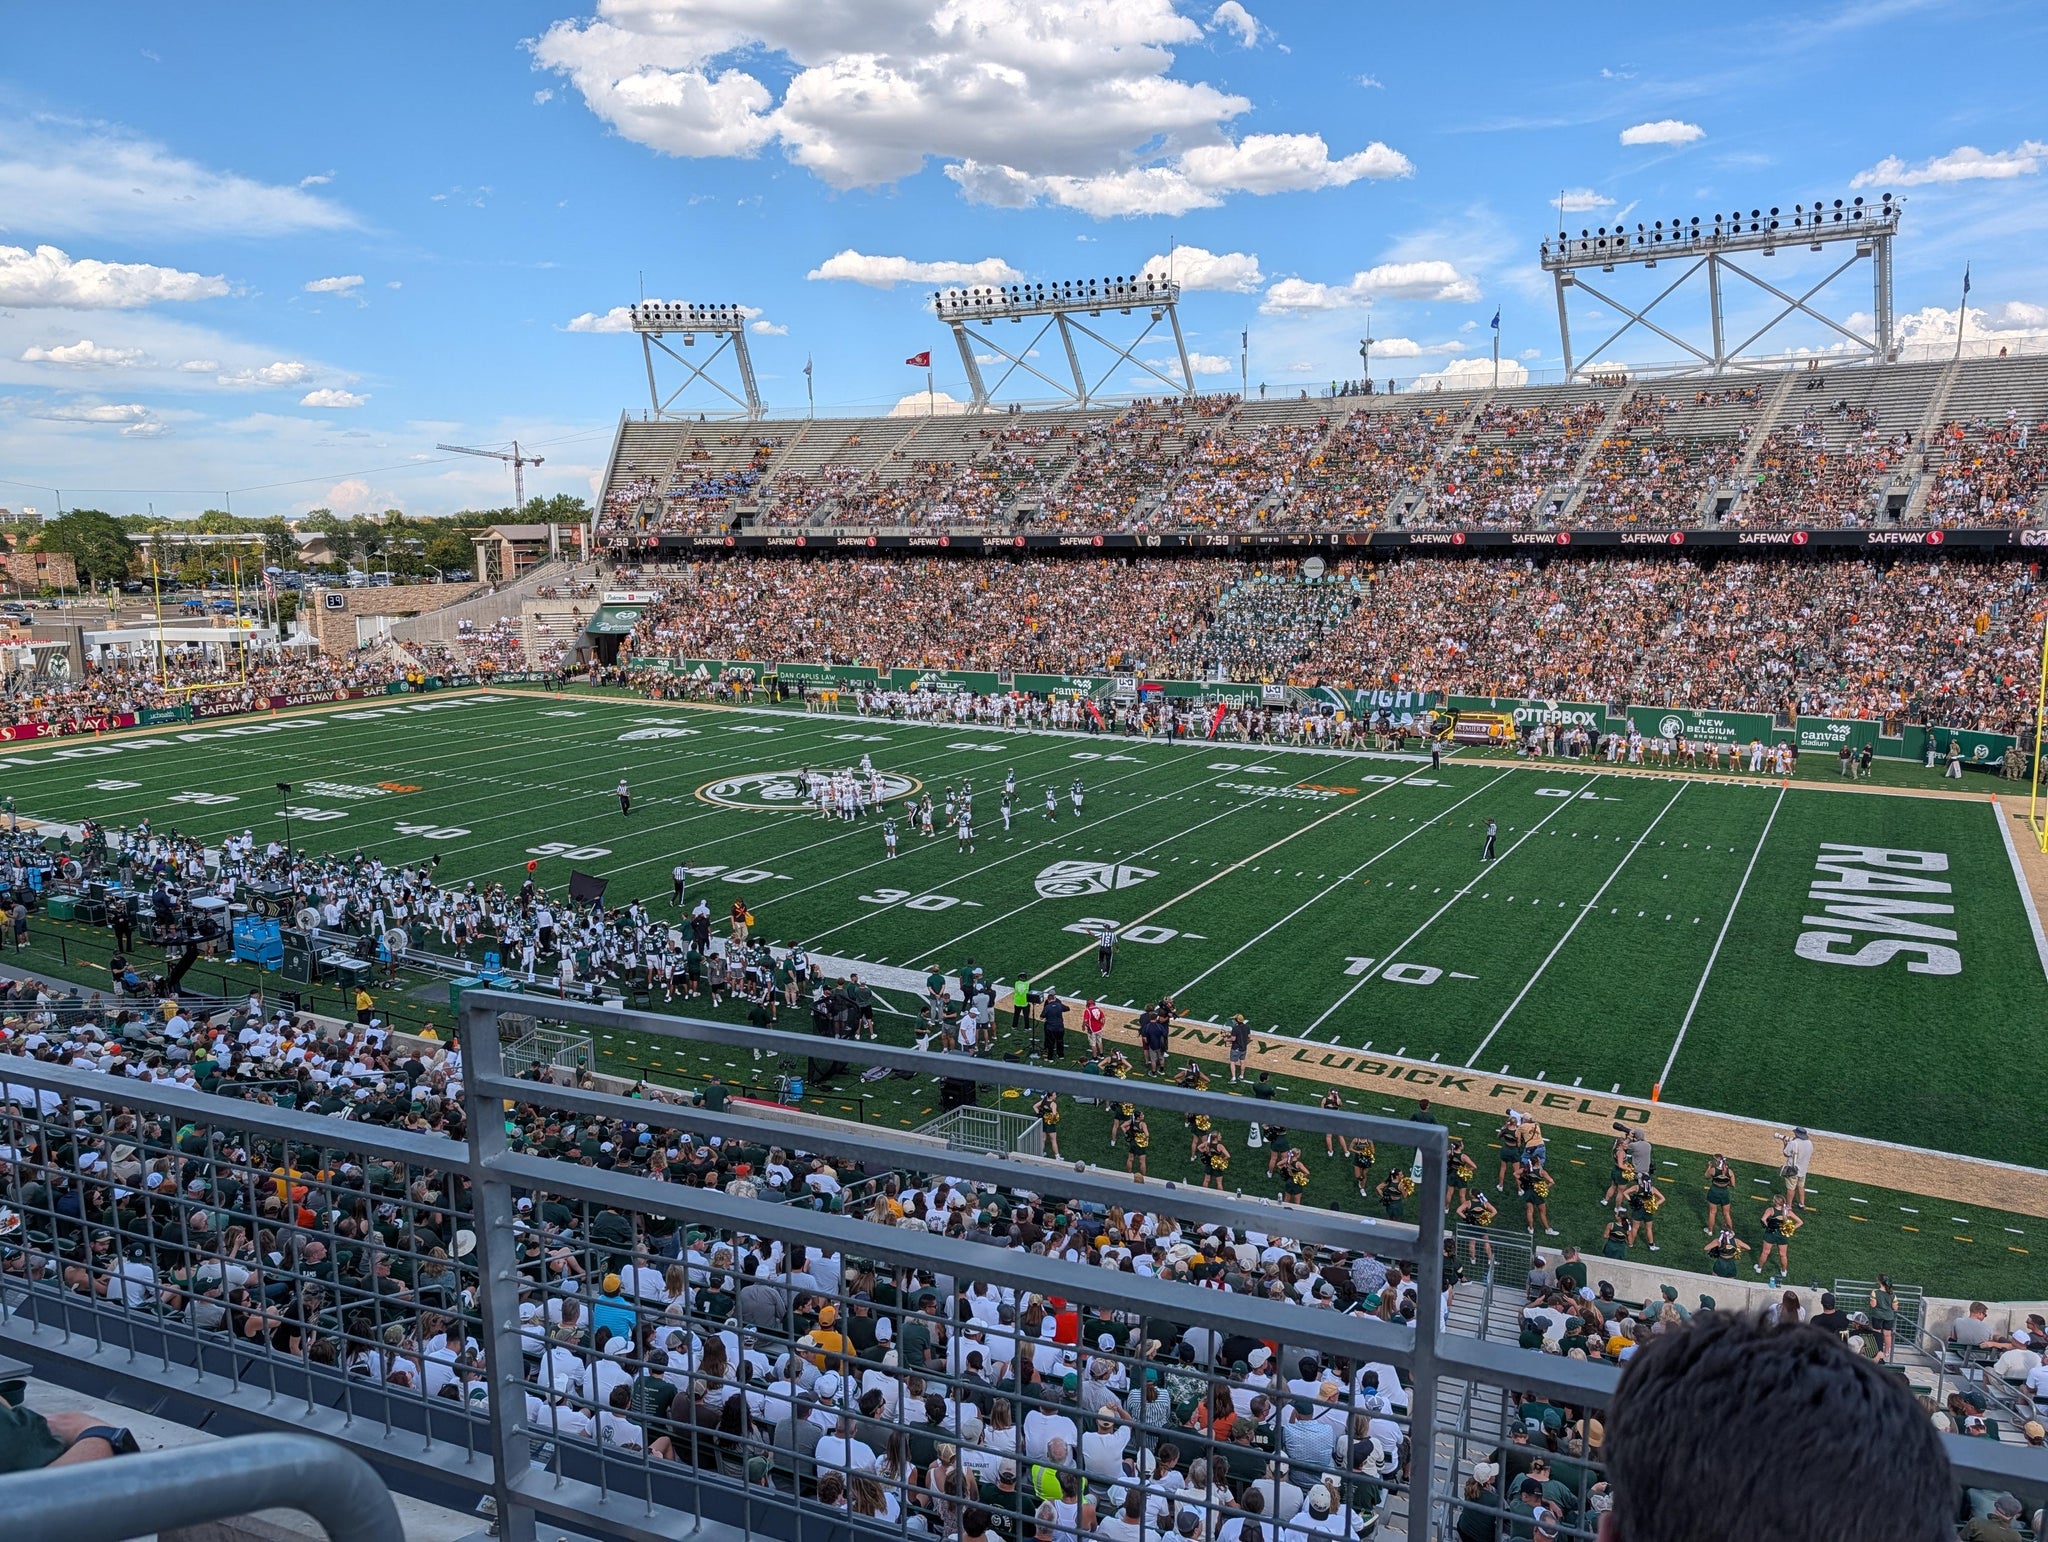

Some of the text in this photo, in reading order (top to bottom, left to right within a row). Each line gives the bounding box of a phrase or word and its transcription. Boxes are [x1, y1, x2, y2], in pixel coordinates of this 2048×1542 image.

[607, 538, 629, 546] 7:59
[693, 537, 725, 545] SAFEWAY
[767, 537, 797, 545] SAFEWAY
[837, 537, 867, 546] SAFEWAY
[908, 537, 939, 546] SAFEWAY
[983, 537, 1015, 545] SAFEWAY
[1059, 537, 1093, 545] SAFEWAY
[1206, 536, 1229, 545] 7:59
[1331, 535, 1338, 544] 0
[1410, 534, 1452, 544] SAFEWAY
[1511, 534, 1556, 544] SAFEWAY
[1620, 534, 1667, 543] SAFEWAY
[1738, 532, 1791, 544] SAFEWAY
[1868, 532, 1926, 544] SAFEWAY
[330, 596, 341, 606] 39
[363, 685, 387, 696] SAFE
[1053, 686, 1089, 697] canvas
[285, 691, 335, 706] SAFEWAY
[1355, 688, 1425, 707] FIGHT
[1513, 707, 1597, 726] OTTERBOX
[1698, 718, 1724, 727] NEW
[36, 718, 101, 736] SAFWAY
[1801, 730, 1846, 742] canvas
[0, 719, 328, 770] LORADO
[1801, 738, 1830, 747] stadium
[1215, 782, 1340, 797] canvas
[1237, 789, 1329, 801] stadium
[275, 807, 349, 821] 30
[393, 824, 472, 840] 40
[525, 842, 612, 860] 50
[687, 865, 776, 884] 40
[858, 889, 962, 911] 30
[1795, 842, 1962, 975] RAMS
[1061, 917, 1179, 944] 20
[1344, 957, 1443, 985] 10
[1290, 1049, 1481, 1093] LUBICK
[1490, 1083, 1652, 1124] FIELD
